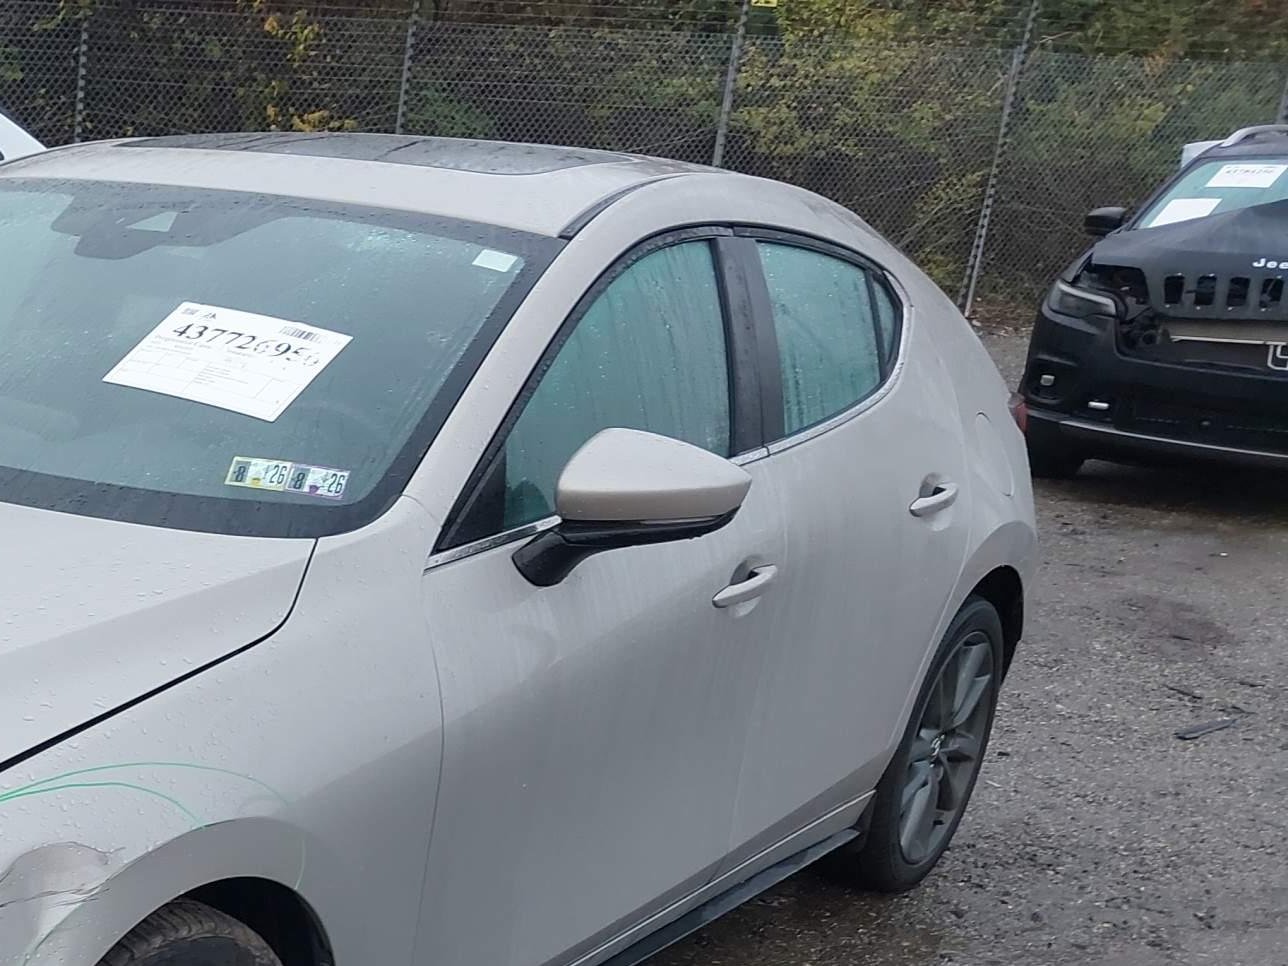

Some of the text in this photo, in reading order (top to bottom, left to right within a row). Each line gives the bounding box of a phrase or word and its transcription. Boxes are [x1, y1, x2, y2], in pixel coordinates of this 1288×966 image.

[1252, 258, 1288, 269] Jee
[235, 464, 287, 484] 8 26
[293, 472, 345, 494] 8 26
